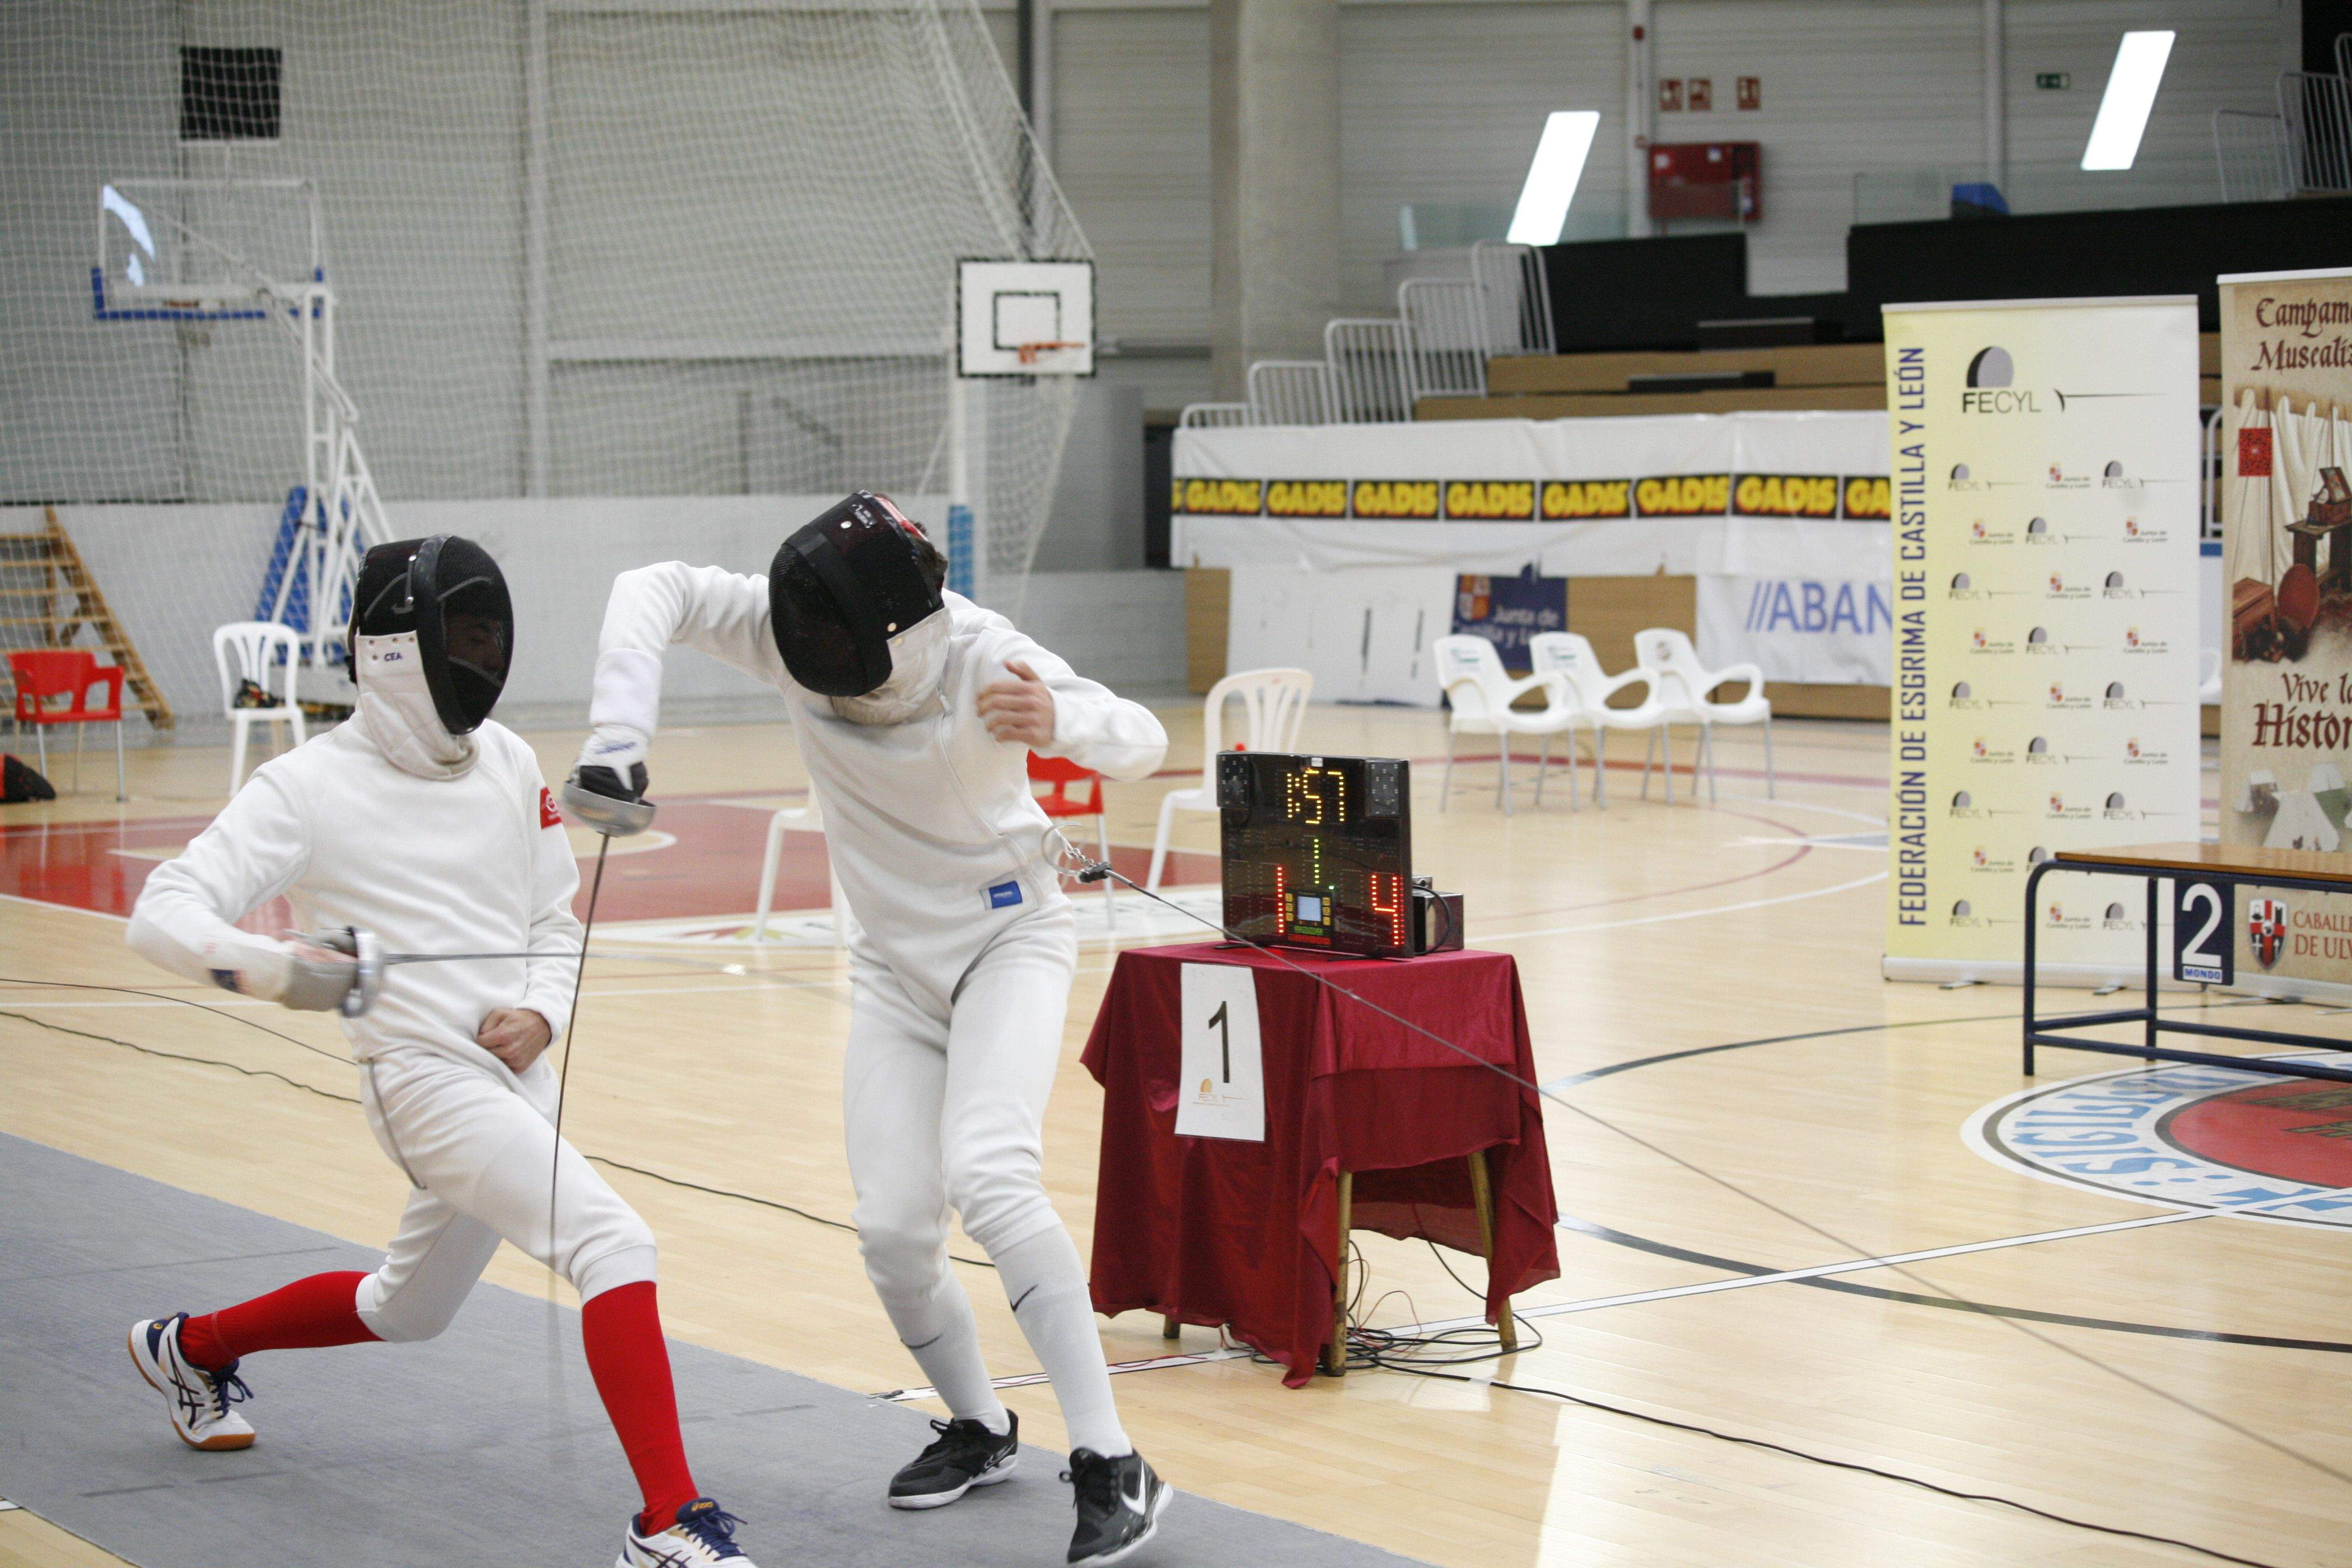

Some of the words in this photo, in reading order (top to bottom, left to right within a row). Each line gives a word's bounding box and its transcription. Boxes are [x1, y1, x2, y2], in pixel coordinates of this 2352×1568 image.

[2256, 297, 2352, 338] Campam
[1893, 348, 1925, 410] LEÓN
[1963, 390, 2041, 413] FECYL
[1899, 420, 1926, 435] Y
[1268, 483, 1346, 516] GADIS
[1354, 482, 1439, 517] GADIS
[1446, 482, 1534, 518] GADIS
[1542, 481, 1629, 519] GADIS
[1636, 475, 1730, 515] GADIS
[1734, 475, 1837, 517] GADIS
[1900, 444, 1926, 560] CASTILLA
[1901, 571, 1926, 600] DE
[1901, 611, 1927, 720] ESGRIMA
[2280, 673, 2329, 704] Vive
[1900, 731, 1927, 761] DE
[1895, 772, 1927, 926] FEDERACIÓN
[1371, 873, 1399, 946] 4
[2182, 883, 2222, 968] 2
[2294, 934, 2318, 957] DE
[2185, 968, 2221, 980] MONDO
[1208, 1000, 1230, 1083] 1
